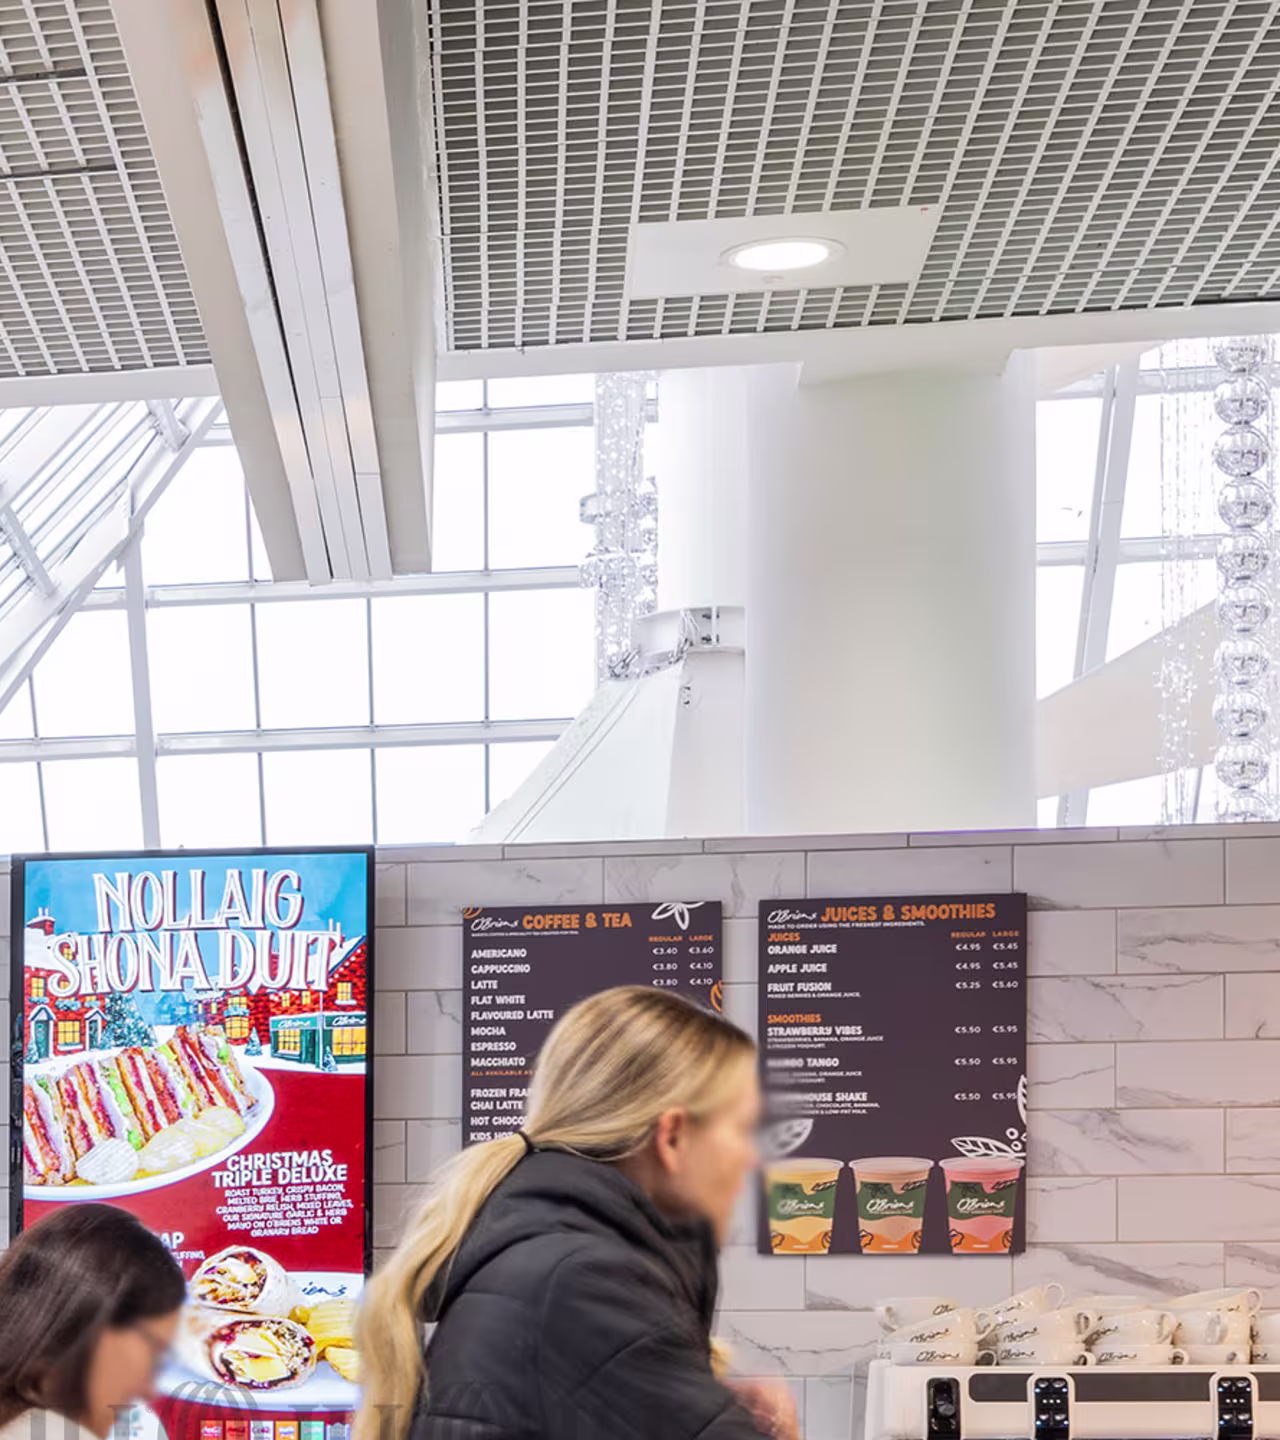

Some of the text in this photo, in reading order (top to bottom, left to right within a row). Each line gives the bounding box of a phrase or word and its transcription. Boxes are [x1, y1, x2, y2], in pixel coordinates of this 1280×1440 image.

[93, 869, 304, 933] NOLLAIG
[821, 907, 877, 922] JUICES
[883, 905, 895, 920] &
[901, 903, 996, 920] SMOOTHIES
[523, 914, 579, 929] COFFEE
[585, 912, 597, 928] &
[603, 913, 632, 928] TEA
[768, 933, 800, 942] JUICES
[652, 946, 714, 955] €3.40 €3.60
[767, 944, 837, 954] ORANGE JUICE
[956, 943, 981, 951] €4.95
[471, 949, 527, 959] AMERICANO
[48, 929, 343, 997] SHONA DUIT
[689, 962, 713, 970] €4.10
[956, 962, 981, 970] €4.95
[471, 964, 530, 974] CAPPUCCINO
[767, 964, 827, 973] APPLE JUICE
[471, 980, 498, 990] LATTE
[767, 982, 832, 992] FRUIT FUSION
[471, 995, 525, 1005] FLAT WHITE
[471, 1010, 554, 1020] FLAVOURED LATTE
[767, 1014, 821, 1024] SMOOTHIES
[471, 1026, 506, 1036] MOCHA
[767, 1026, 862, 1036] STRAWBERRY VIBES
[955, 1026, 981, 1034] €5.50
[471, 1042, 516, 1051] ESPRESSO
[471, 1057, 526, 1067] MACCHIATO
[806, 1058, 839, 1067] TANGO
[471, 1088, 507, 1097] FROZEN
[835, 1092, 868, 1101] SHAKE
[471, 1101, 523, 1110] CHAI LATTE
[470, 1116, 526, 1125] HOT CHOCO
[470, 1132, 491, 1141] KIDS
[227, 1150, 333, 1171] CHRISTMAS
[212, 1164, 347, 1188] TRIPLE DELUXE
